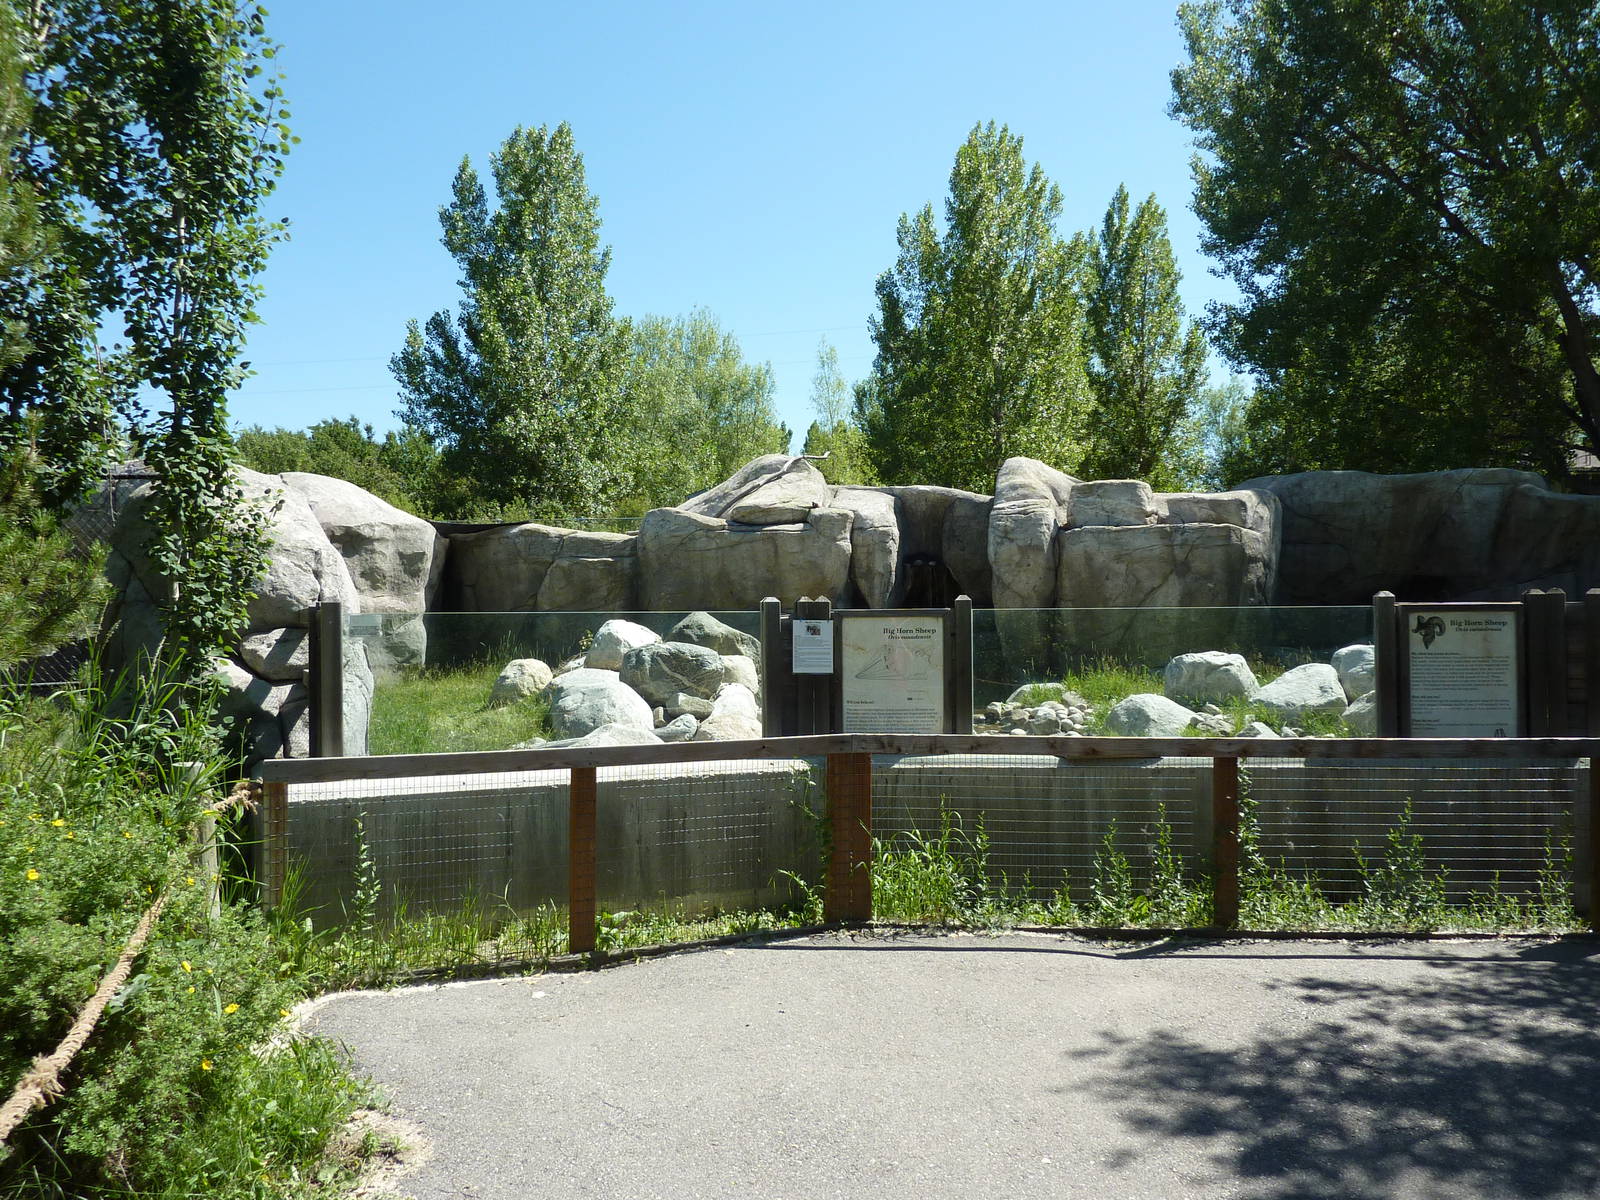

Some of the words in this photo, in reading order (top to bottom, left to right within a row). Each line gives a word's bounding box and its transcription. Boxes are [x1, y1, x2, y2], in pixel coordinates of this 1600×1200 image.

[1450, 619, 1463, 627] Big
[1485, 619, 1508, 627] Sheep
[883, 627, 895, 635] Big
[915, 627, 937, 635] Sheep
